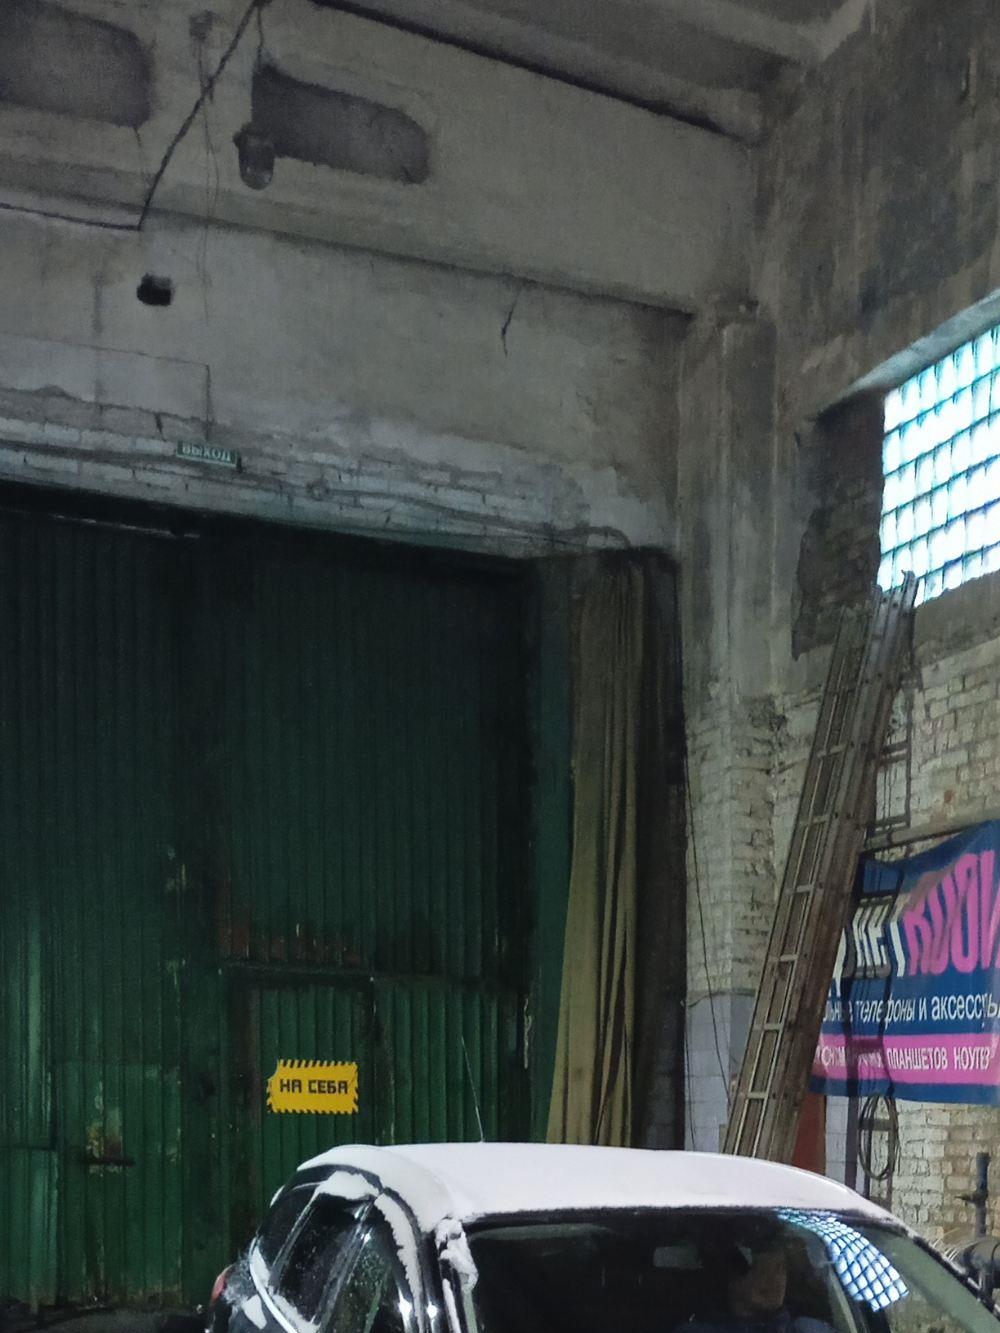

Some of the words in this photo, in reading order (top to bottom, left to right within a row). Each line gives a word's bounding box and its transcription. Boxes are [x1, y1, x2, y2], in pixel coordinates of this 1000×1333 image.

[919, 997, 928, 1021] и
[887, 1047, 948, 1070] ПЛАНШЕТОВ
[280, 1079, 302, 1093] НА
